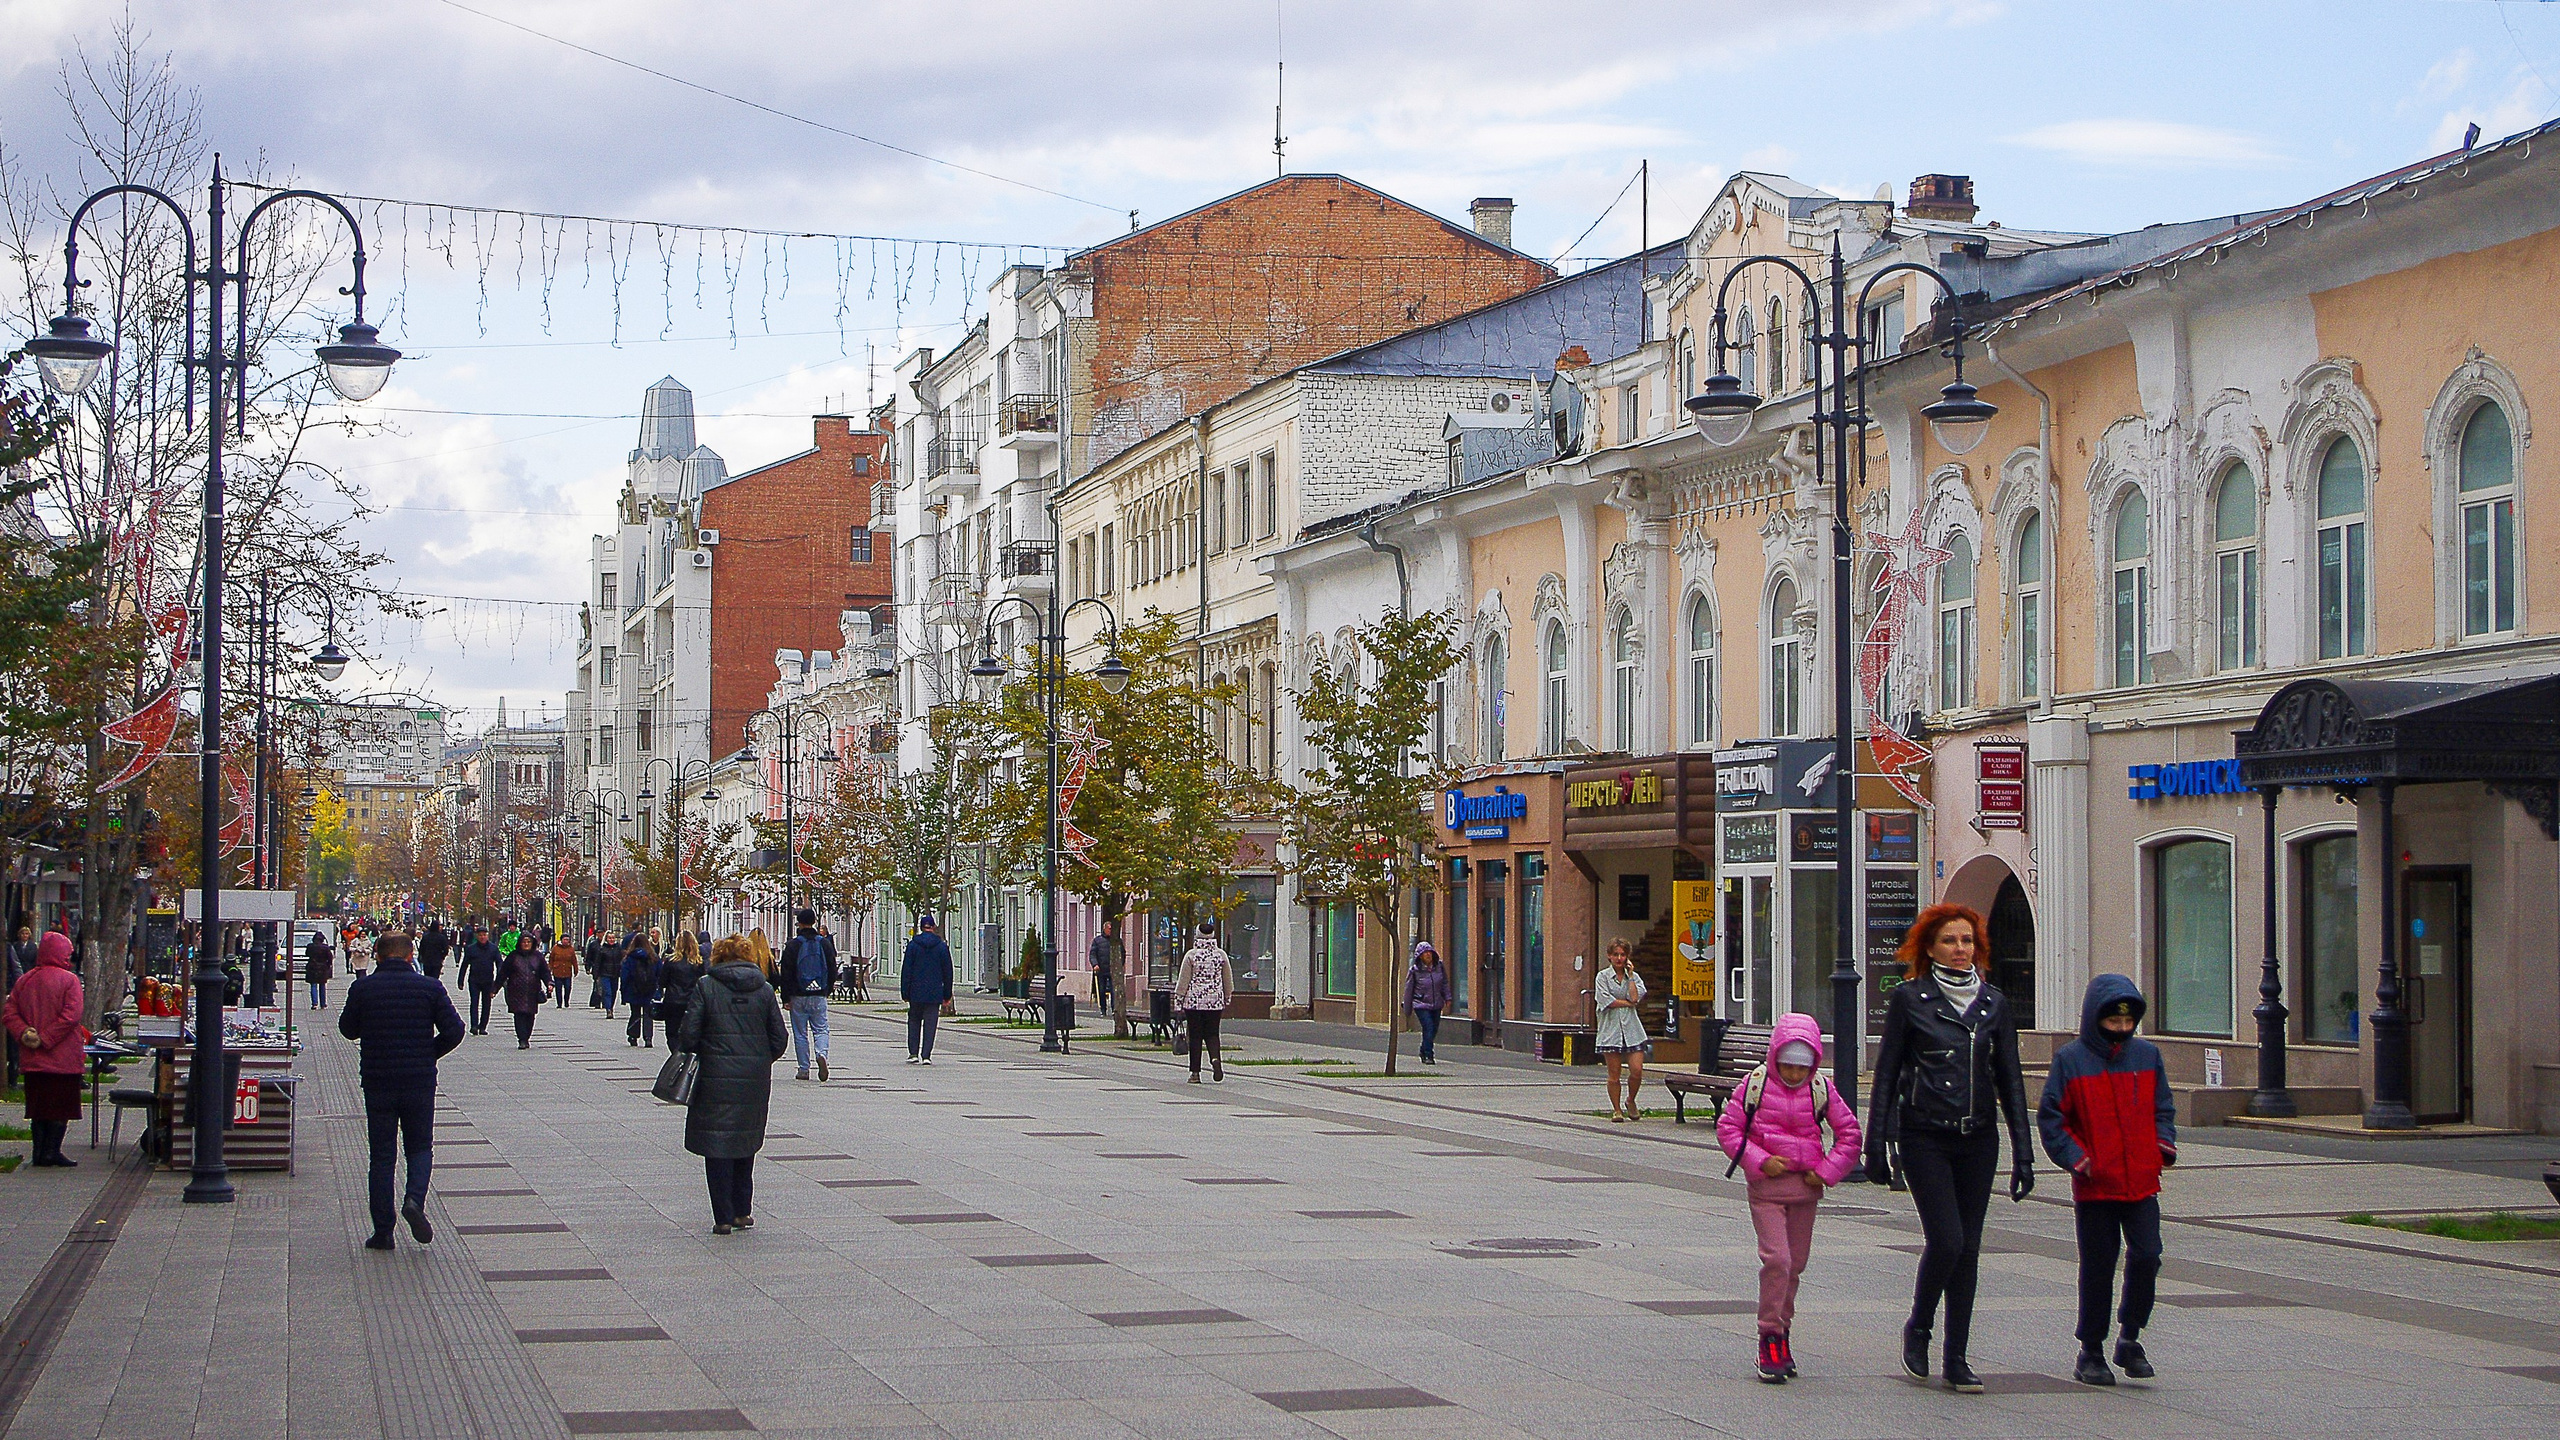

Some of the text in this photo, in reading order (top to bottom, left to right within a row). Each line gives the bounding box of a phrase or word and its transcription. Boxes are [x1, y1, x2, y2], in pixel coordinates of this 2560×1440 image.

[1716, 764, 1773, 795] FALCON
[1570, 769, 1658, 808] ШЕРСТЬ ЛЁН
[1818, 827, 1830, 835] ЧАС
[1883, 850, 1911, 859] PS5
[1871, 880, 1909, 889] ИГРОВЫЕ
[1866, 892, 1916, 900] КОМПЬЮТЕРЫ
[1683, 908, 1714, 920] ПИРОГ
[1883, 937, 1899, 945] ЧАС
[1869, 947, 1875, 955] В
[1681, 980, 1714, 996] БЫСТР
